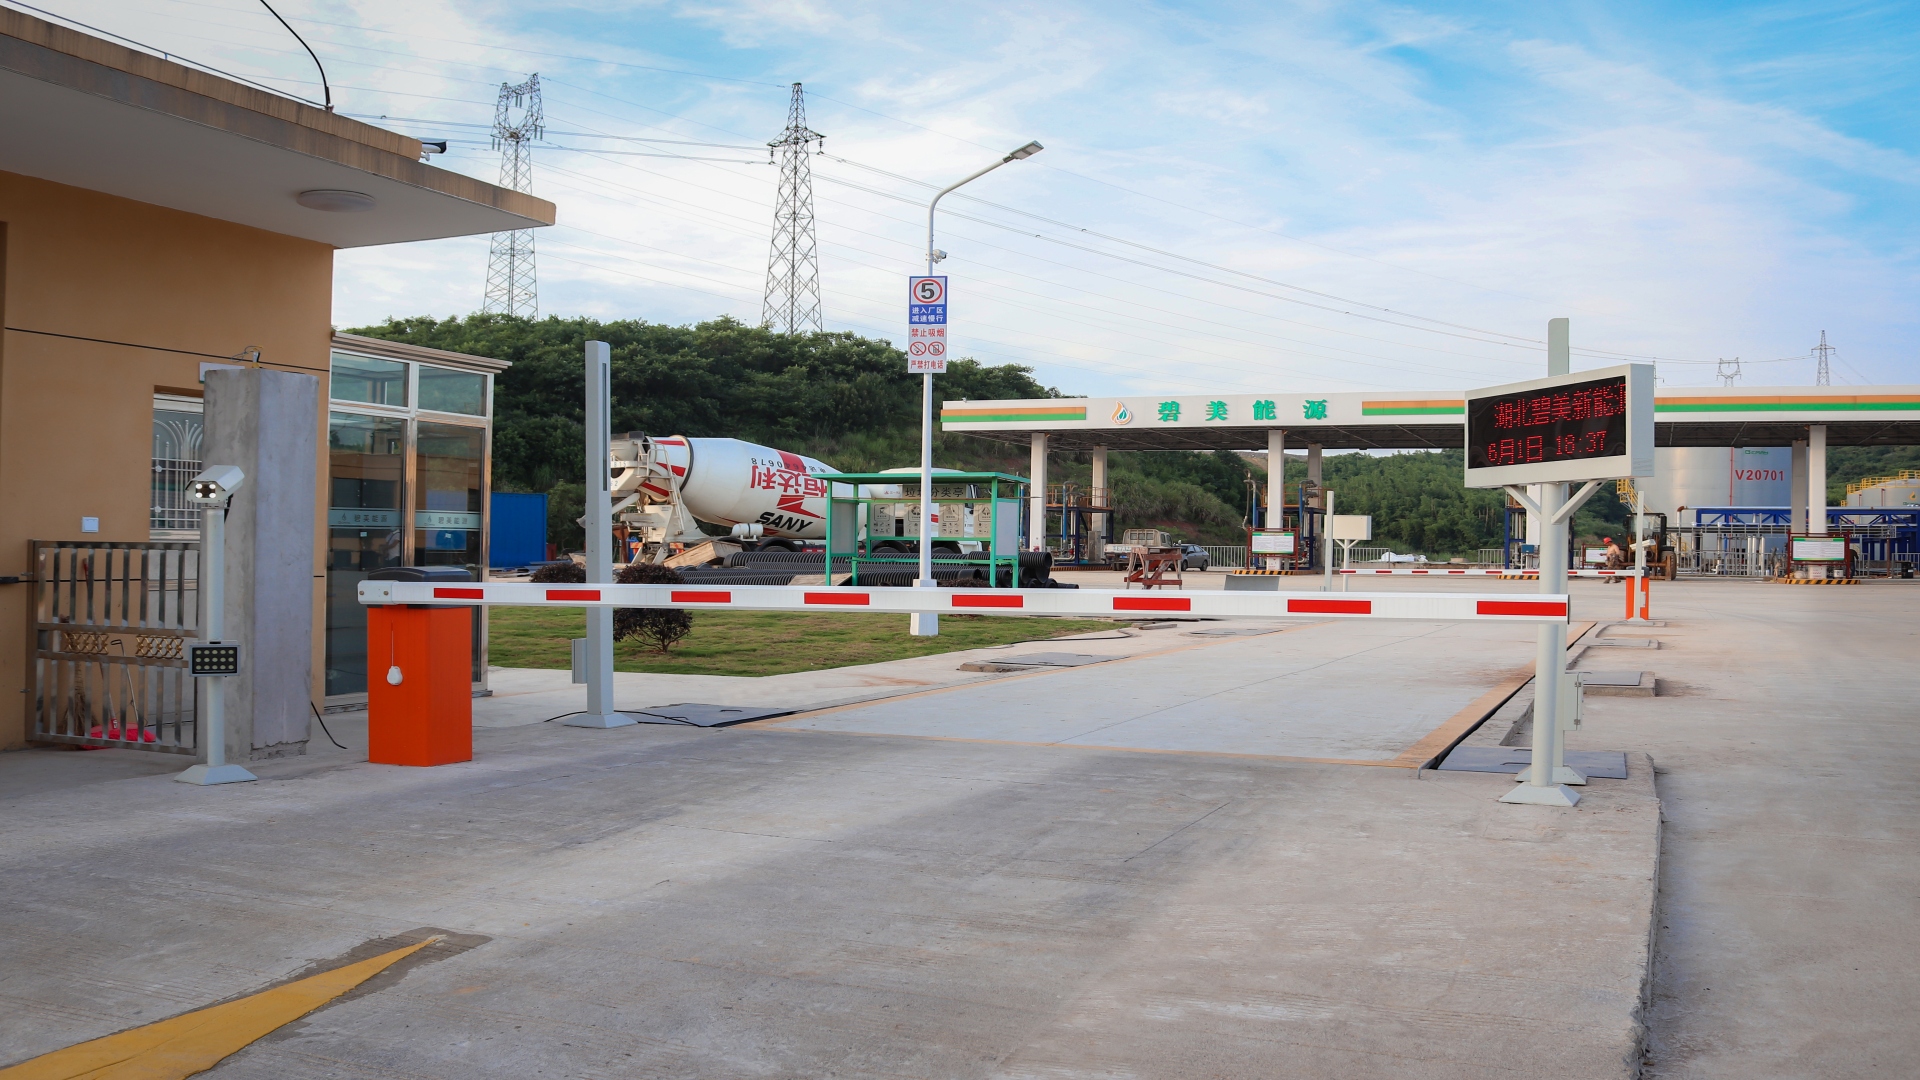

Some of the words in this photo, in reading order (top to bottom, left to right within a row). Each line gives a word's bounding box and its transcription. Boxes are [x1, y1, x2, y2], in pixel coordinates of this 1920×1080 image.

[920, 282, 935, 300] 5
[911, 306, 944, 314] 进入厂区
[911, 314, 944, 323] 减速慢行
[911, 328, 945, 338] 禁止吸烟
[910, 360, 944, 370] 严禁打电话
[1157, 399, 1328, 422] 碧美能源
[1487, 435, 1543, 465] 6月1日
[1556, 430, 1607, 455] 18:37
[750, 464, 828, 498] 恒达利
[1735, 469, 1784, 482] V20701
[755, 511, 814, 533] SANY
